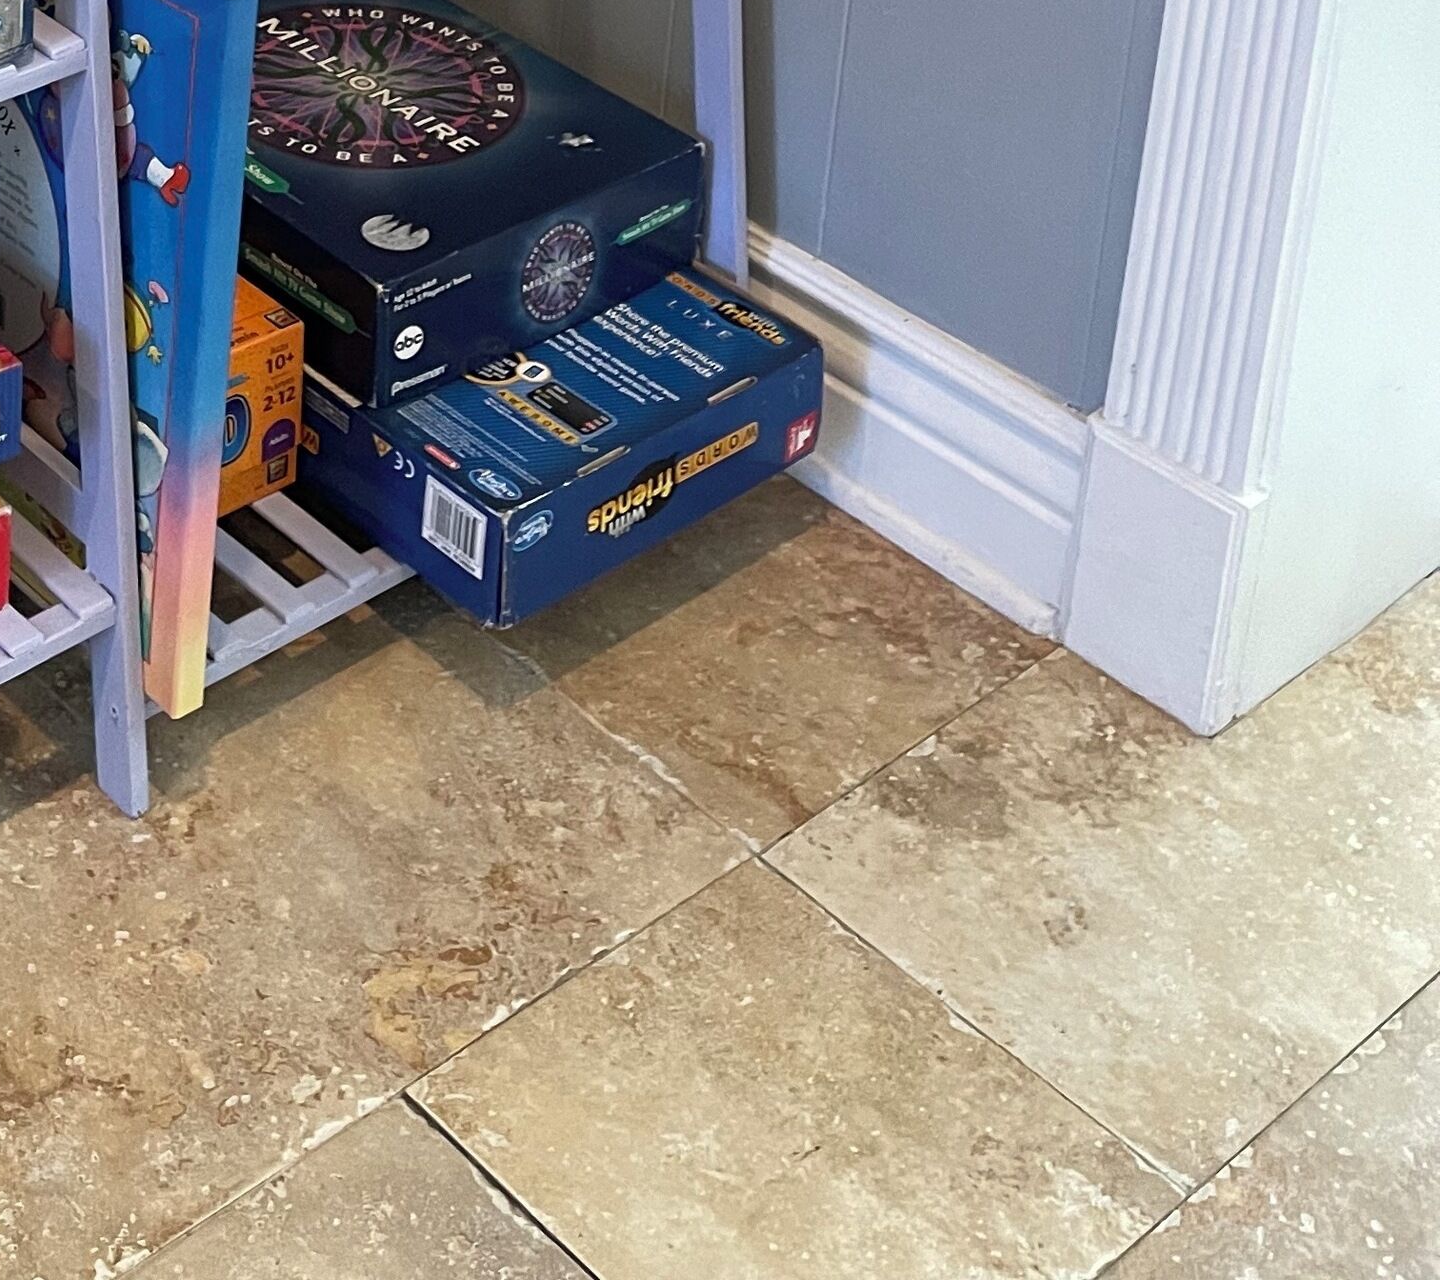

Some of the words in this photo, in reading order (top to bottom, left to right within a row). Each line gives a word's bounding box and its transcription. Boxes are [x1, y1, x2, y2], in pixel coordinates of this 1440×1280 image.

[321, 7, 385, 20] WHO
[401, 13, 484, 53] WANTS
[483, 56, 508, 76] TO
[256, 16, 482, 154] MILLIONAIRE
[496, 82, 515, 104] BE
[491, 108, 510, 120] A
[285, 137, 319, 155] TO
[334, 150, 375, 165] BE
[391, 153, 409, 164] A
[247, 163, 276, 186] Show
[665, 299, 734, 339] LUXE
[718, 302, 787, 346] friends
[394, 332, 423, 353] abc
[592, 315, 664, 359] experience!
[604, 307, 641, 335] Words
[641, 332, 670, 352] With
[670, 349, 715, 379] Friends
[616, 303, 650, 327] Share
[650, 324, 672, 339] the
[669, 338, 726, 374] premium
[265, 351, 295, 375] 10+
[262, 385, 297, 413] 2-12
[677, 423, 759, 483] WORDS
[586, 473, 678, 535] friends
